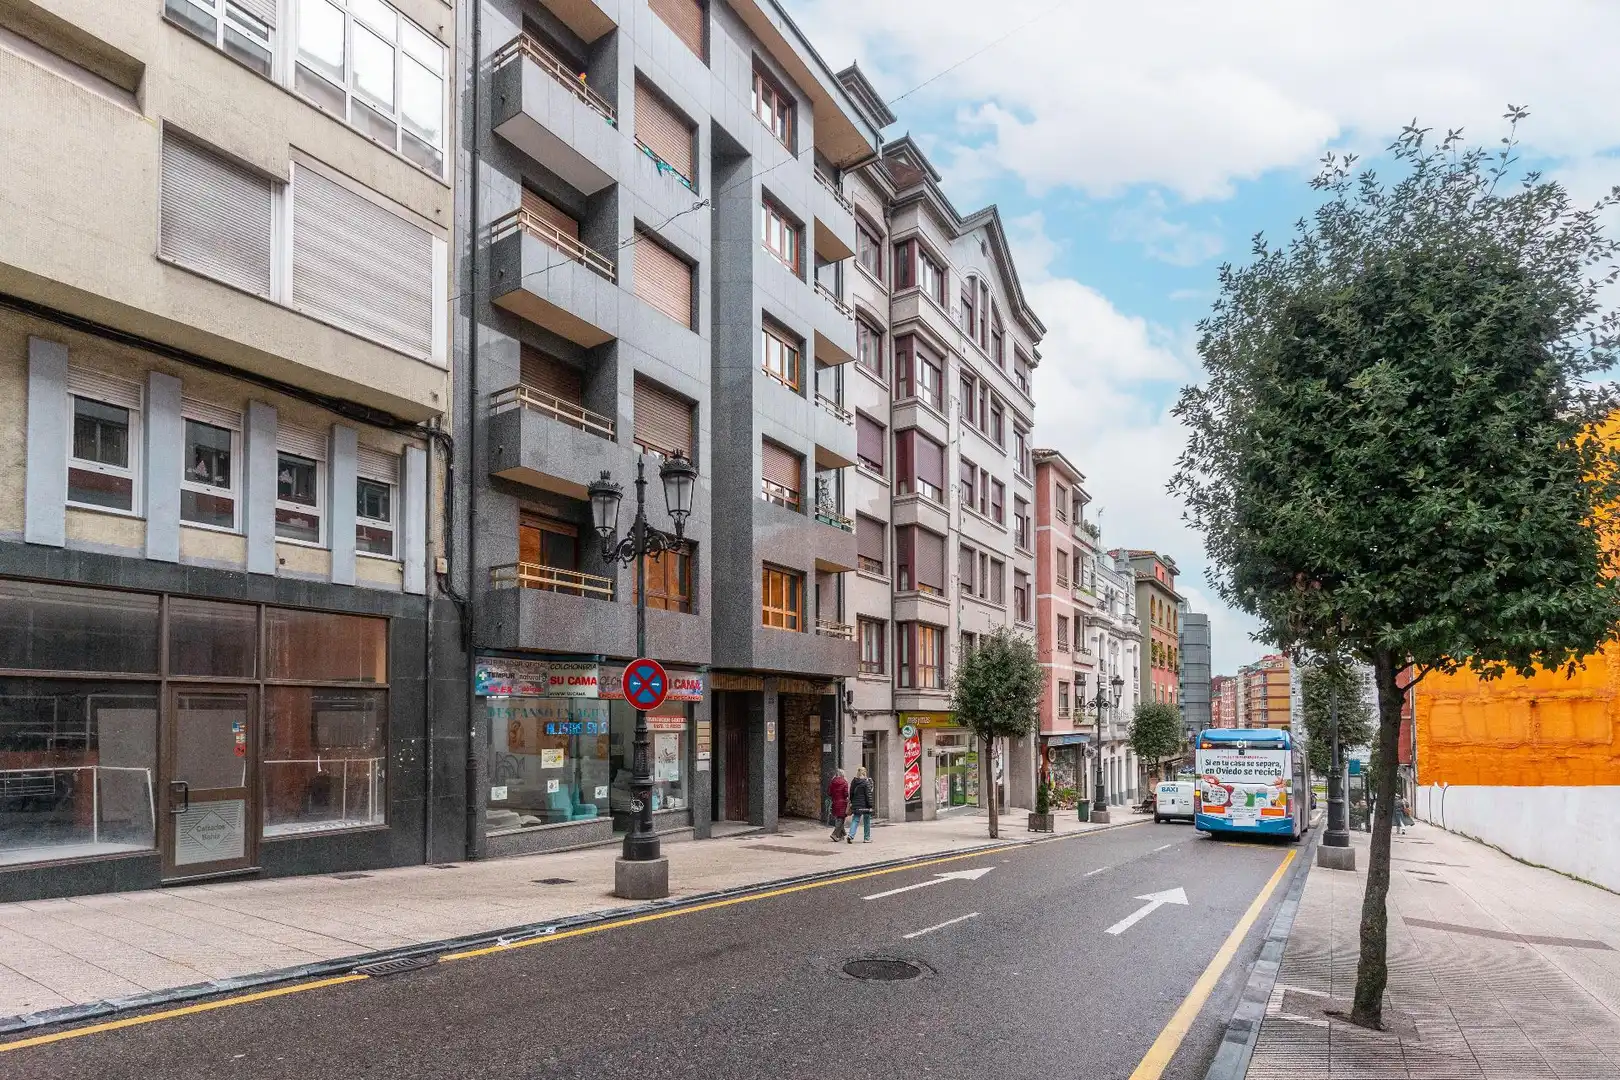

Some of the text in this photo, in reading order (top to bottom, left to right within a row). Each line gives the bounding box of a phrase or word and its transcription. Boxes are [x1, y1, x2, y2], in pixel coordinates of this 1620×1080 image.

[487, 671, 515, 679] TEMPUR
[550, 676, 597, 686] SU CAMA
[674, 678, 701, 690] CAMA
[1236, 740, 1248, 749] C1
[1256, 761, 1282, 769] separa,
[1216, 767, 1242, 775] Oviedo
[1254, 768, 1282, 776] recicla
